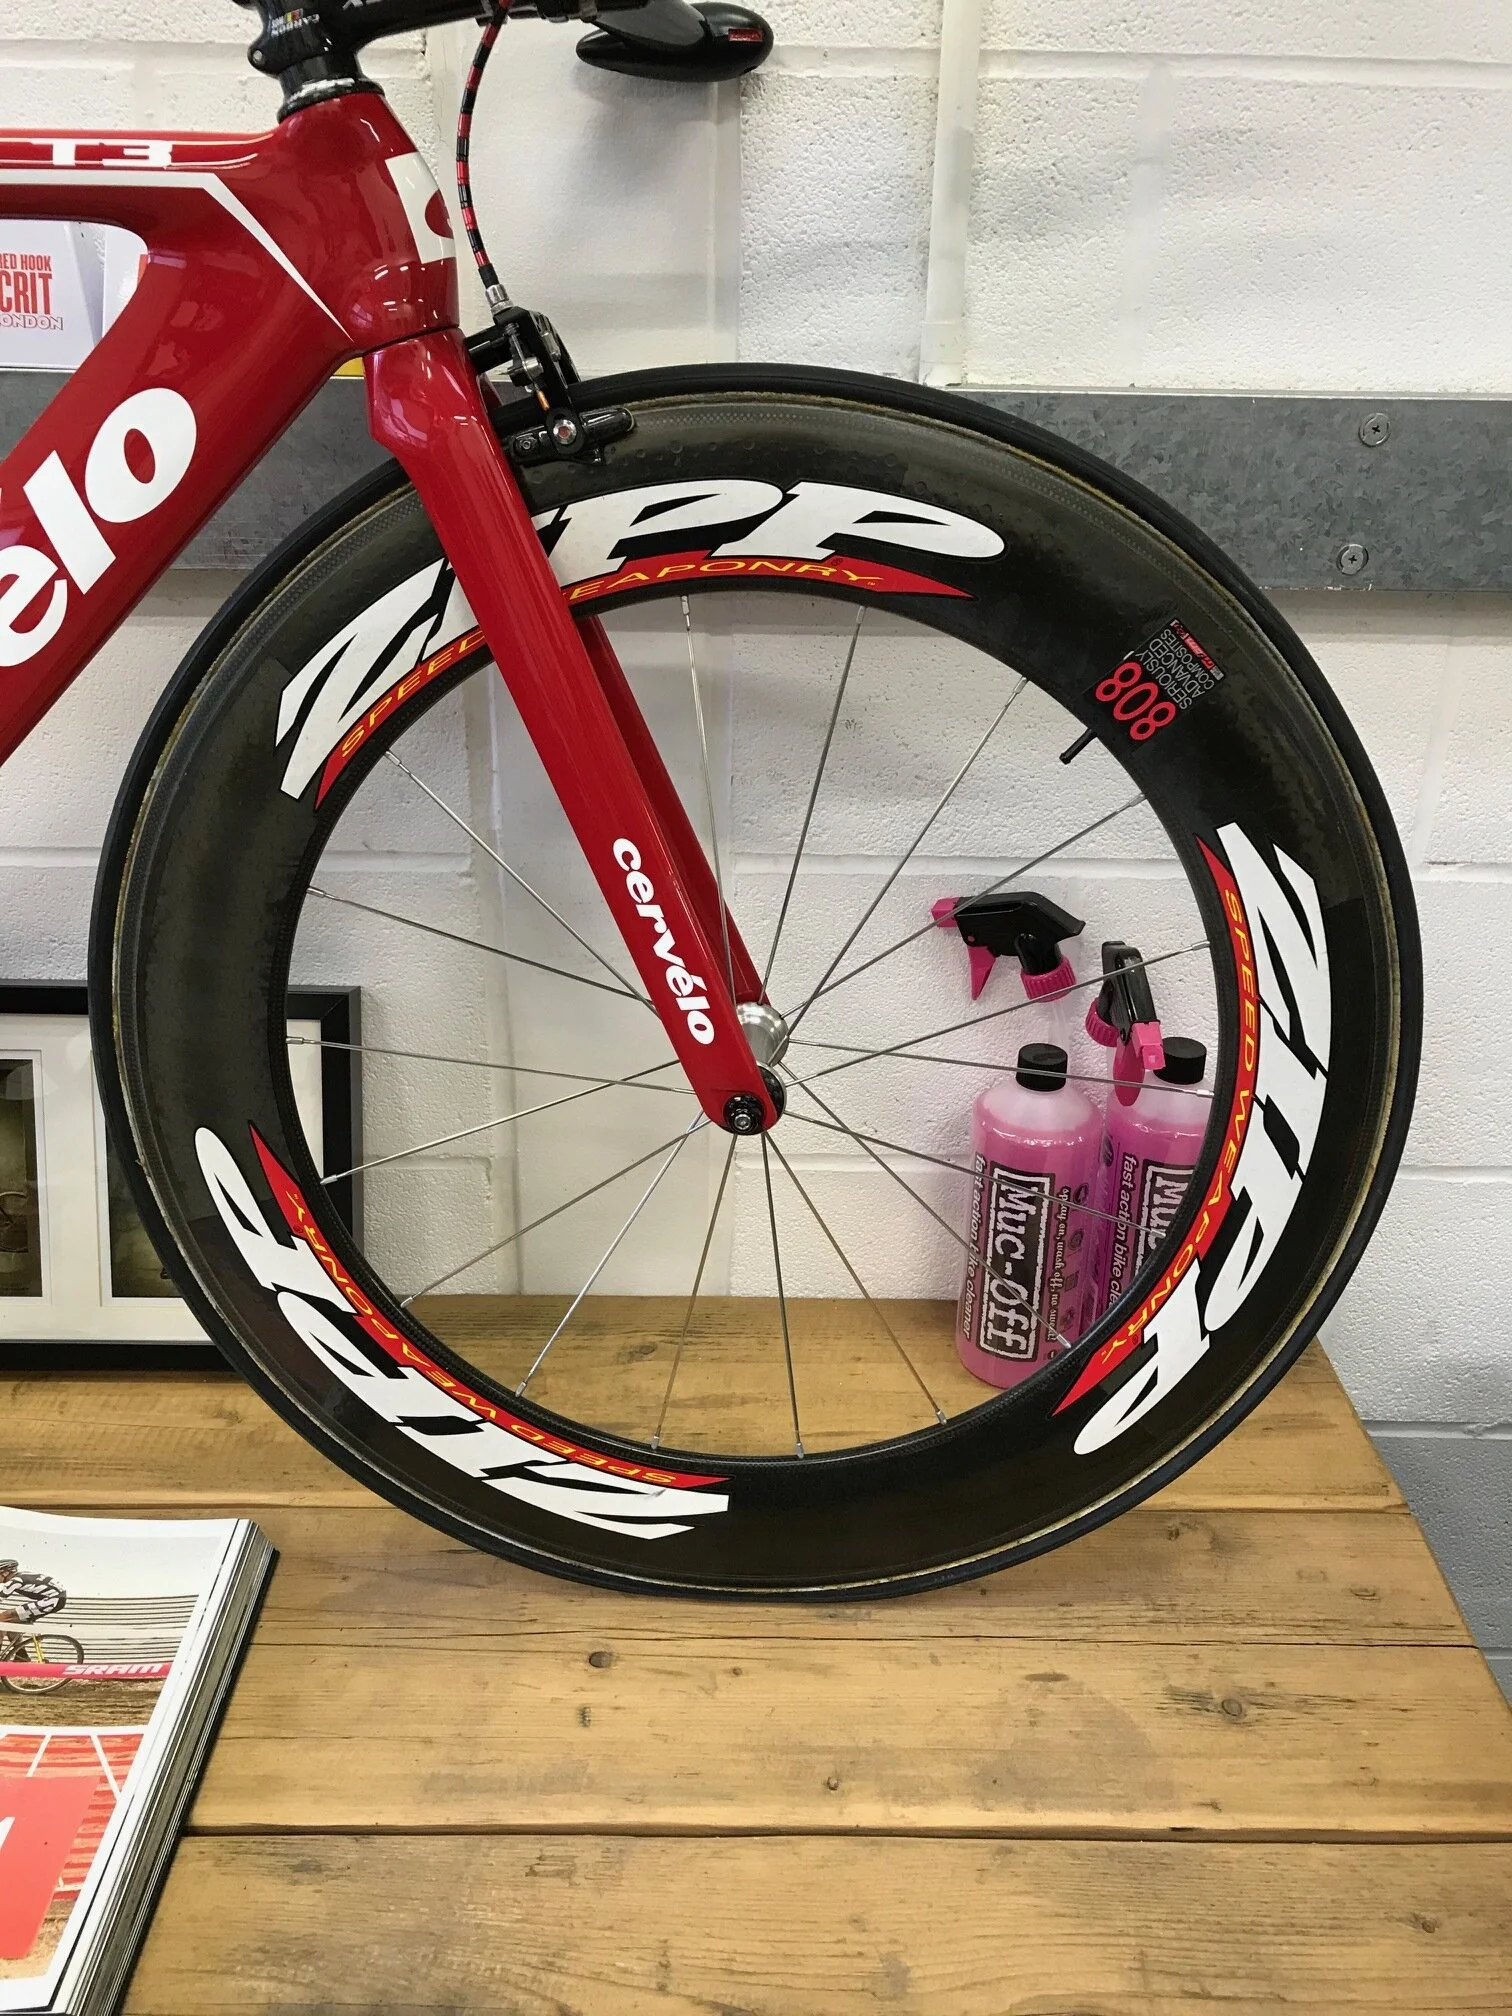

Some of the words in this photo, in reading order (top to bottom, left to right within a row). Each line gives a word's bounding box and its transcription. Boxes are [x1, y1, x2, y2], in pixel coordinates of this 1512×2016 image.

[30, 138, 173, 167] T3
[20, 254, 52, 272] HOOK
[0, 270, 52, 315] CRIT
[0, 314, 63, 331] ONDON
[563, 560, 885, 601] EAPONRY
[1135, 650, 1192, 710] SERIOUSLY
[1149, 638, 1205, 698] ADVANCED
[1160, 629, 1215, 690] COMPOSITES
[1095, 662, 1176, 740] 808
[612, 838, 715, 1044] cervélo
[1225, 888, 1256, 1072] SPEED
[1121, 1155, 1137, 1189] fast
[970, 1189, 981, 1239] action
[1056, 1188, 1068, 1220] spay
[1101, 1089, 1250, 1364] WEAPONRY
[1055, 1242, 1065, 1269] wash
[1112, 1243, 1127, 1278] bike
[286, 1190, 497, 1419] WEAPONRY
[962, 1279, 974, 1338] cleaner
[1051, 1294, 1058, 1306] no
[510, 1423, 677, 1485] SPEED
[62, 1663, 163, 1677] SRAM
